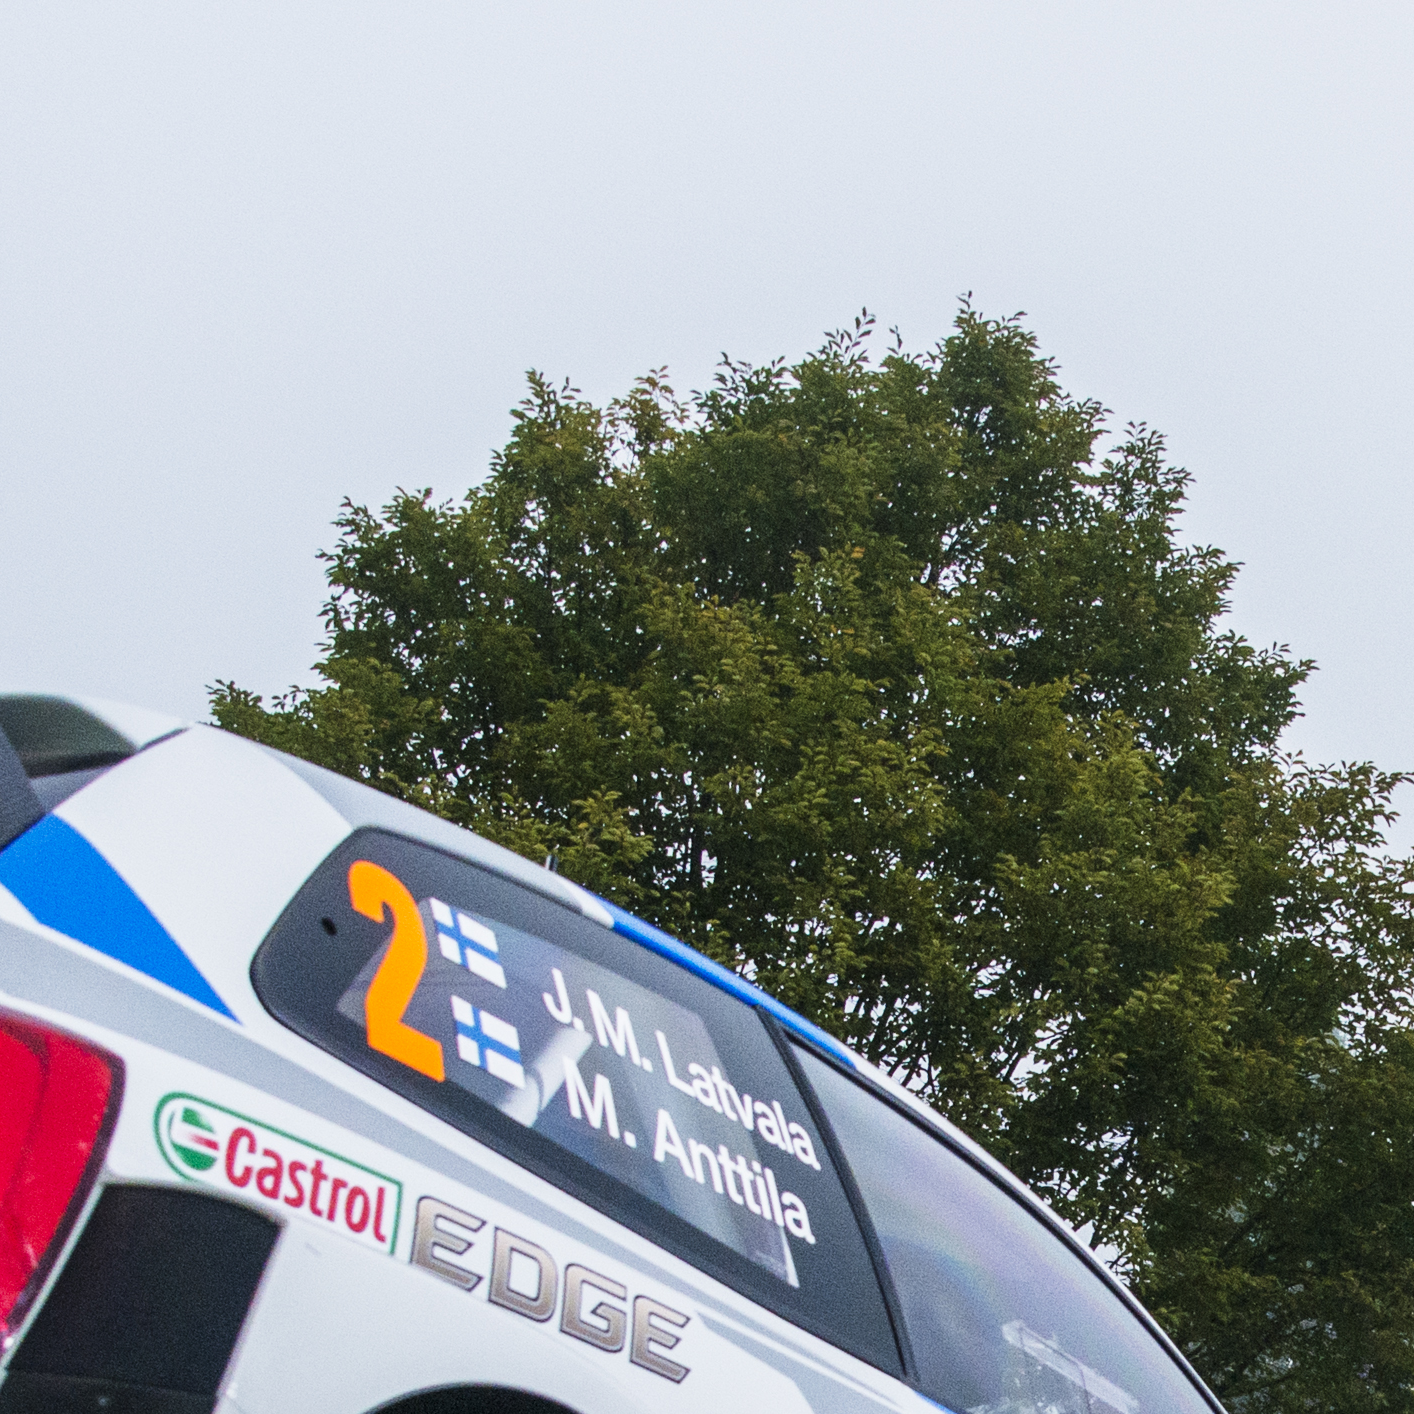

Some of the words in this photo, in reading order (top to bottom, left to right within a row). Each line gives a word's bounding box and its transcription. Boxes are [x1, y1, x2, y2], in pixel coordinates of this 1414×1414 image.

[348, 860, 445, 1082] 2
[562, 1055, 637, 1149] M.
[653, 1109, 817, 1245] Anttila
[655, 1028, 822, 1172] Latvala
[223, 1125, 388, 1243] Castrol
[409, 1195, 692, 1384] EDGE
